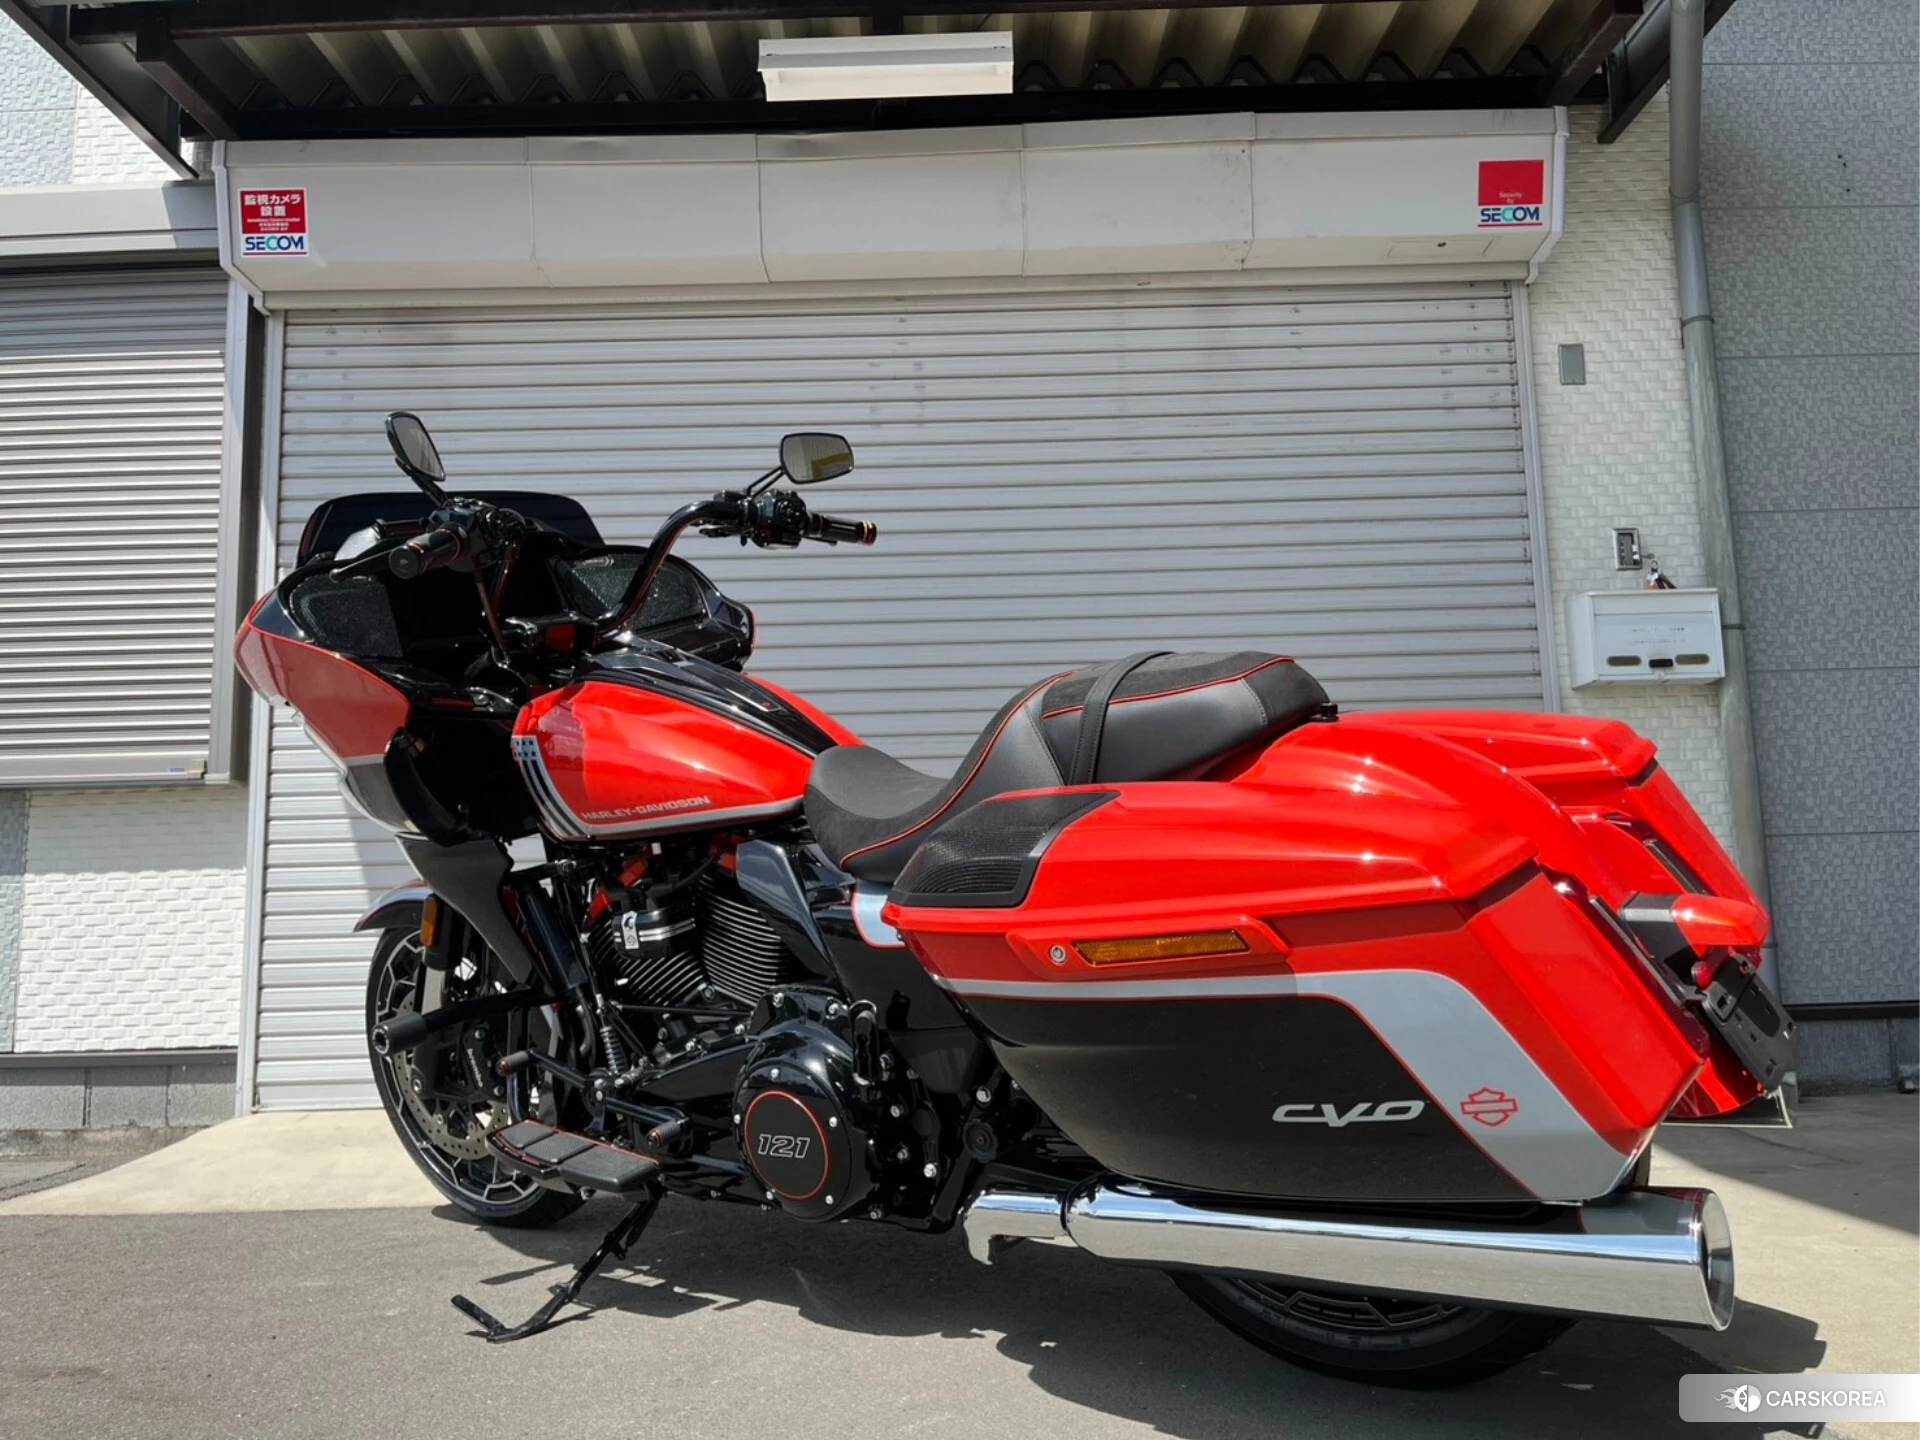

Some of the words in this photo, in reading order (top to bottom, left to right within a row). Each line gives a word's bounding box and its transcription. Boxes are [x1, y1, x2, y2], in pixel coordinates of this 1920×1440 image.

[1480, 206, 1540, 223] SECOM
[245, 235, 304, 251] SECOM
[581, 796, 711, 820] HARLEY-DAVIDSON
[1272, 1100, 1425, 1128] CVO
[758, 1133, 810, 1159] 121
